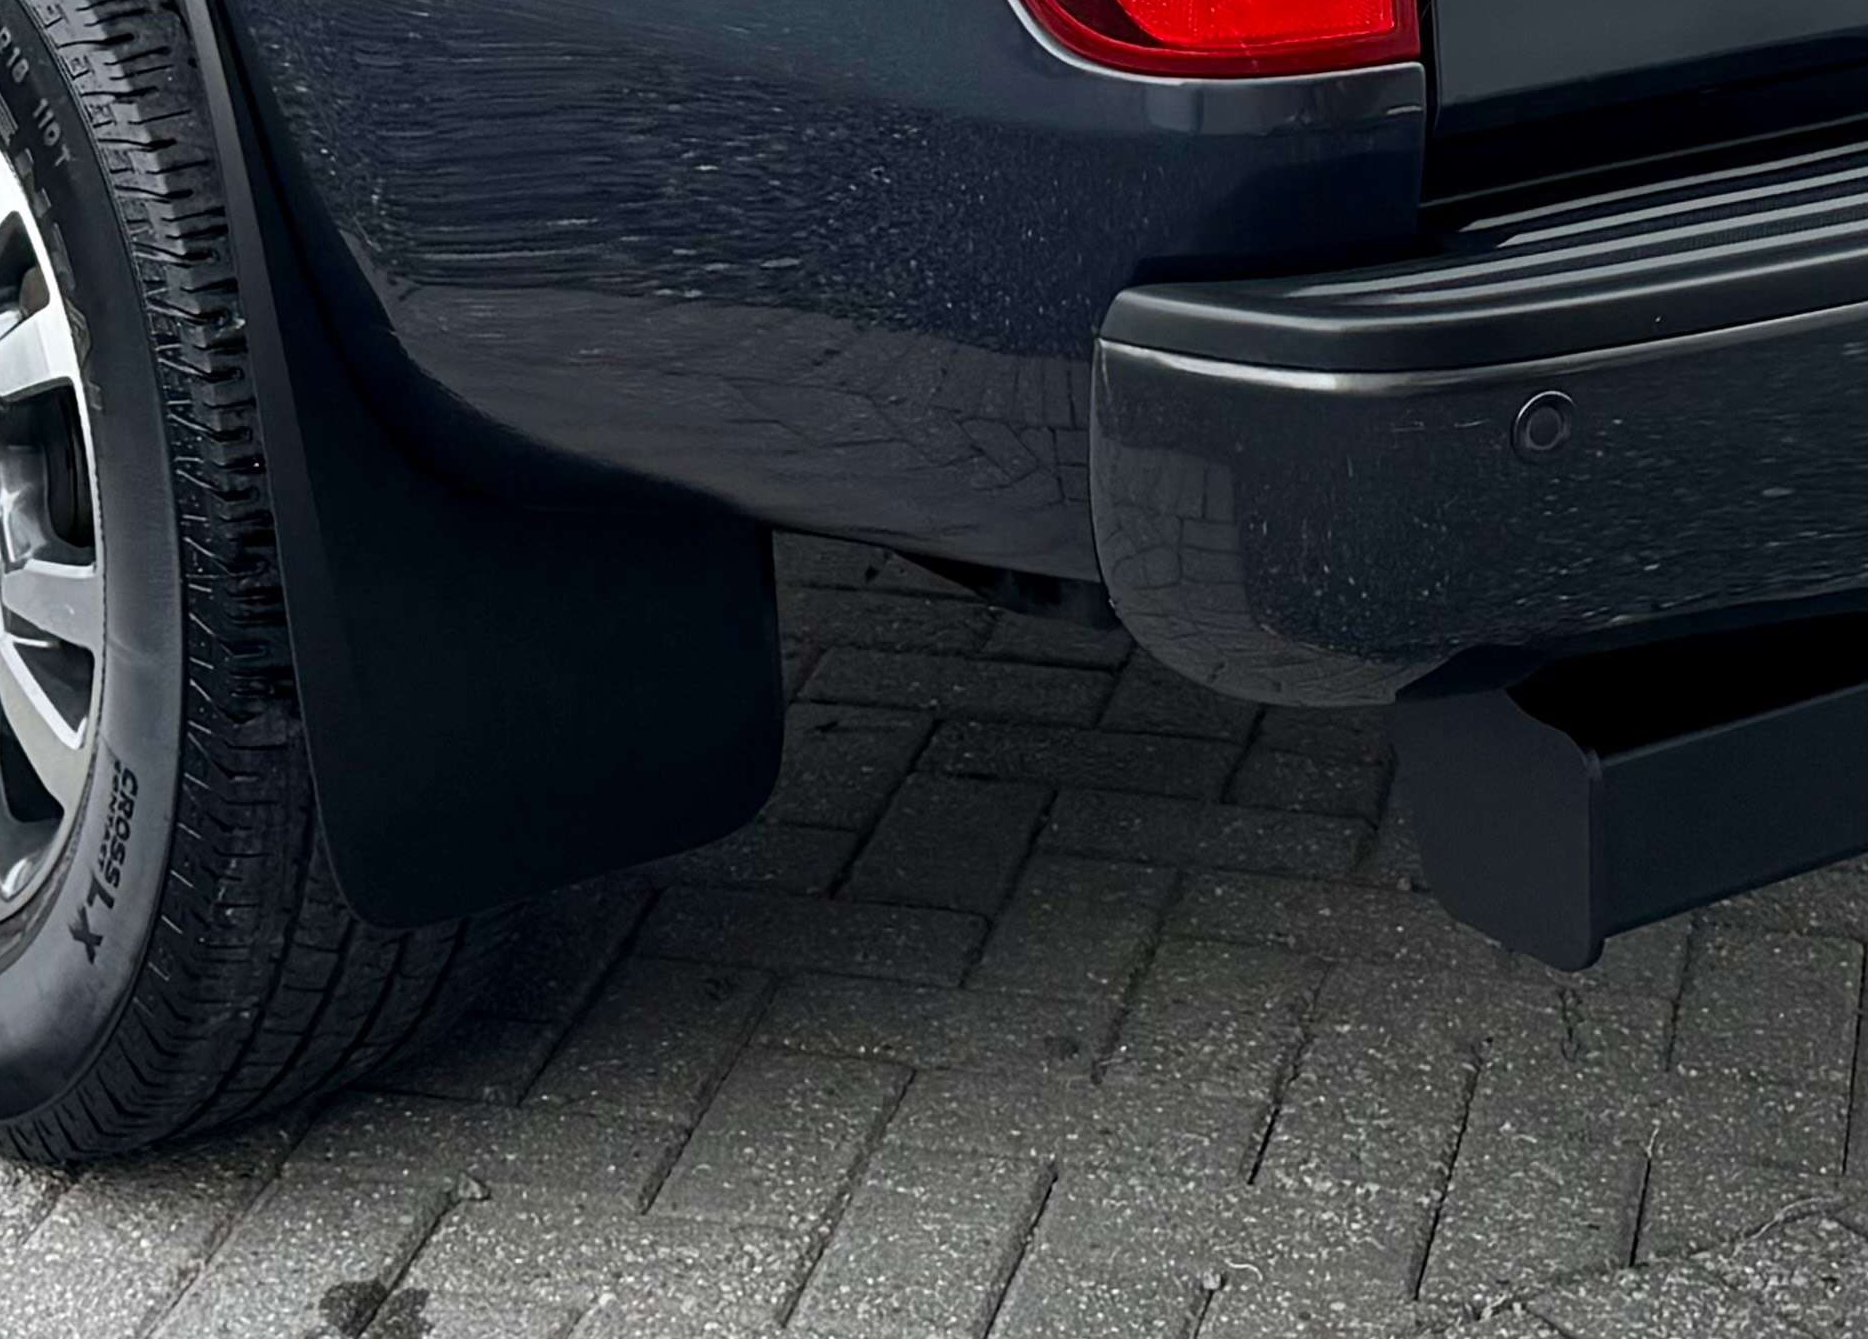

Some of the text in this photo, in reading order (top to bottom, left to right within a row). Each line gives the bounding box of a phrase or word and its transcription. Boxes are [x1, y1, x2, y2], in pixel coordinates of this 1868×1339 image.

[31, 97, 74, 168] 110T
[67, 766, 140, 967] CROSS LX
